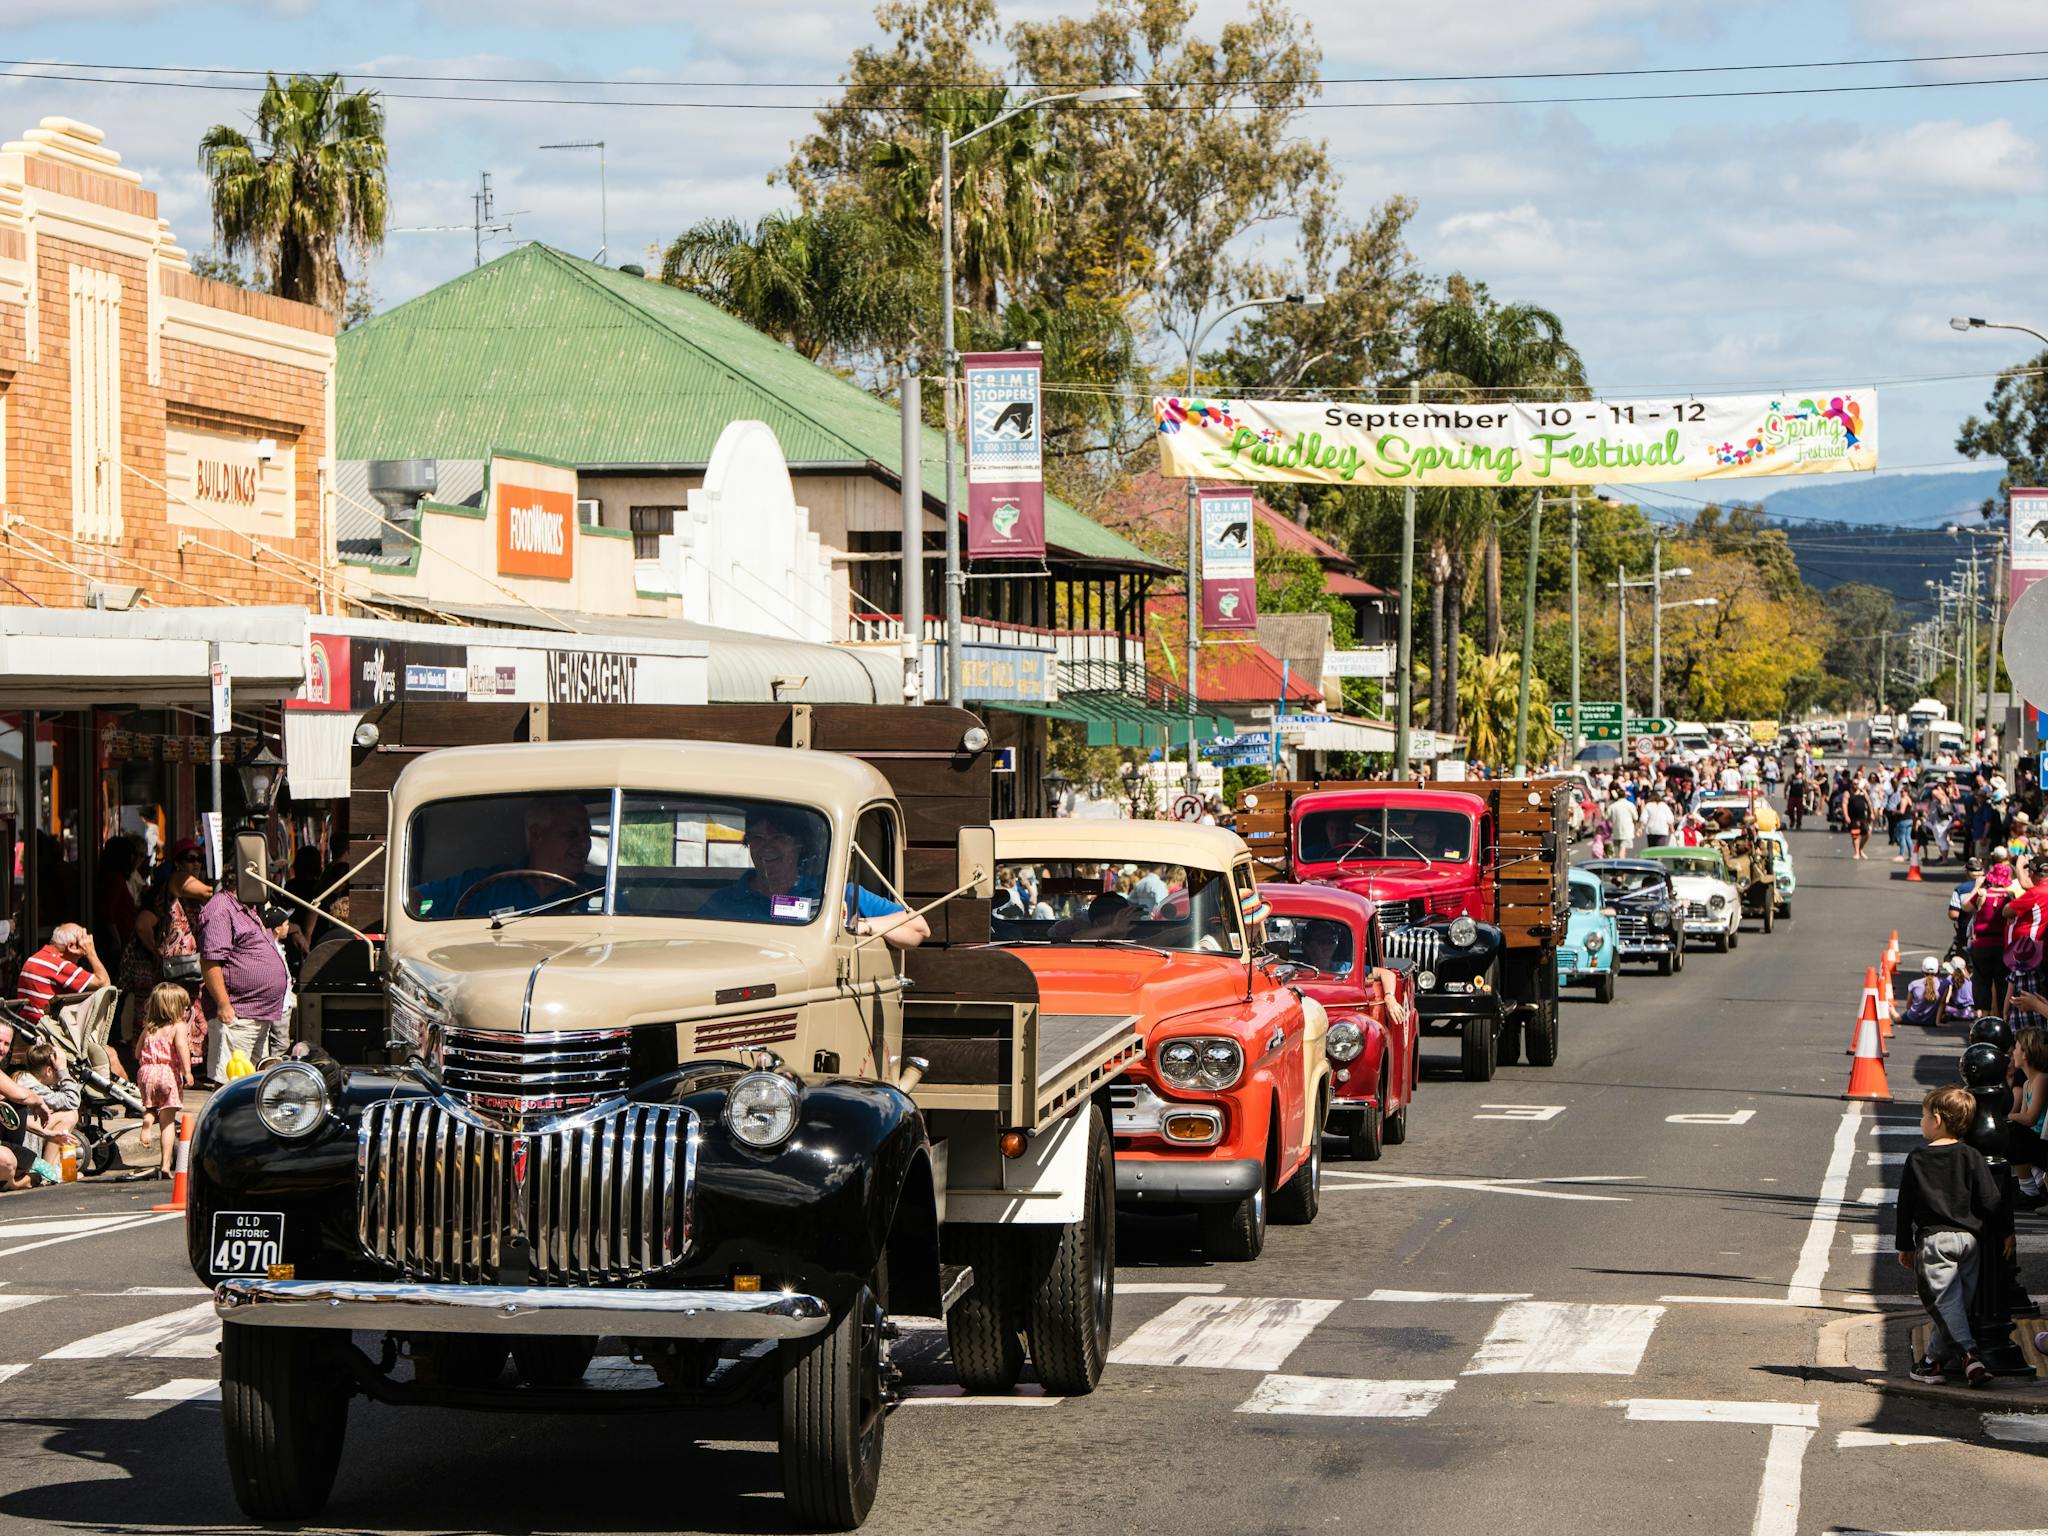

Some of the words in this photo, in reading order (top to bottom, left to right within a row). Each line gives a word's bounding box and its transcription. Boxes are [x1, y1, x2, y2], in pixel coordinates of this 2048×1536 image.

[974, 373, 1034, 387] CRIME
[974, 389, 1035, 400] STOPPERS
[1325, 408, 1508, 431] September
[1536, 408, 1571, 426] 10
[1610, 406, 1634, 424] 11
[1673, 403, 1705, 422] 12
[1765, 413, 1844, 445] Spring
[1374, 433, 1522, 482] Spring
[1530, 429, 1684, 477] Festival
[198, 459, 256, 503] BUILDINGS
[1205, 502, 1248, 512] CRIME
[2015, 502, 2048, 511] CRIM
[547, 651, 638, 703] NEWSAGENT
[1224, 733, 1267, 745] HOSPITAL
[484, 1097, 564, 1110] CHEVROLET
[236, 1216, 260, 1227] QLD
[225, 1229, 270, 1238] HISTORIC
[215, 1240, 278, 1271] 4970
